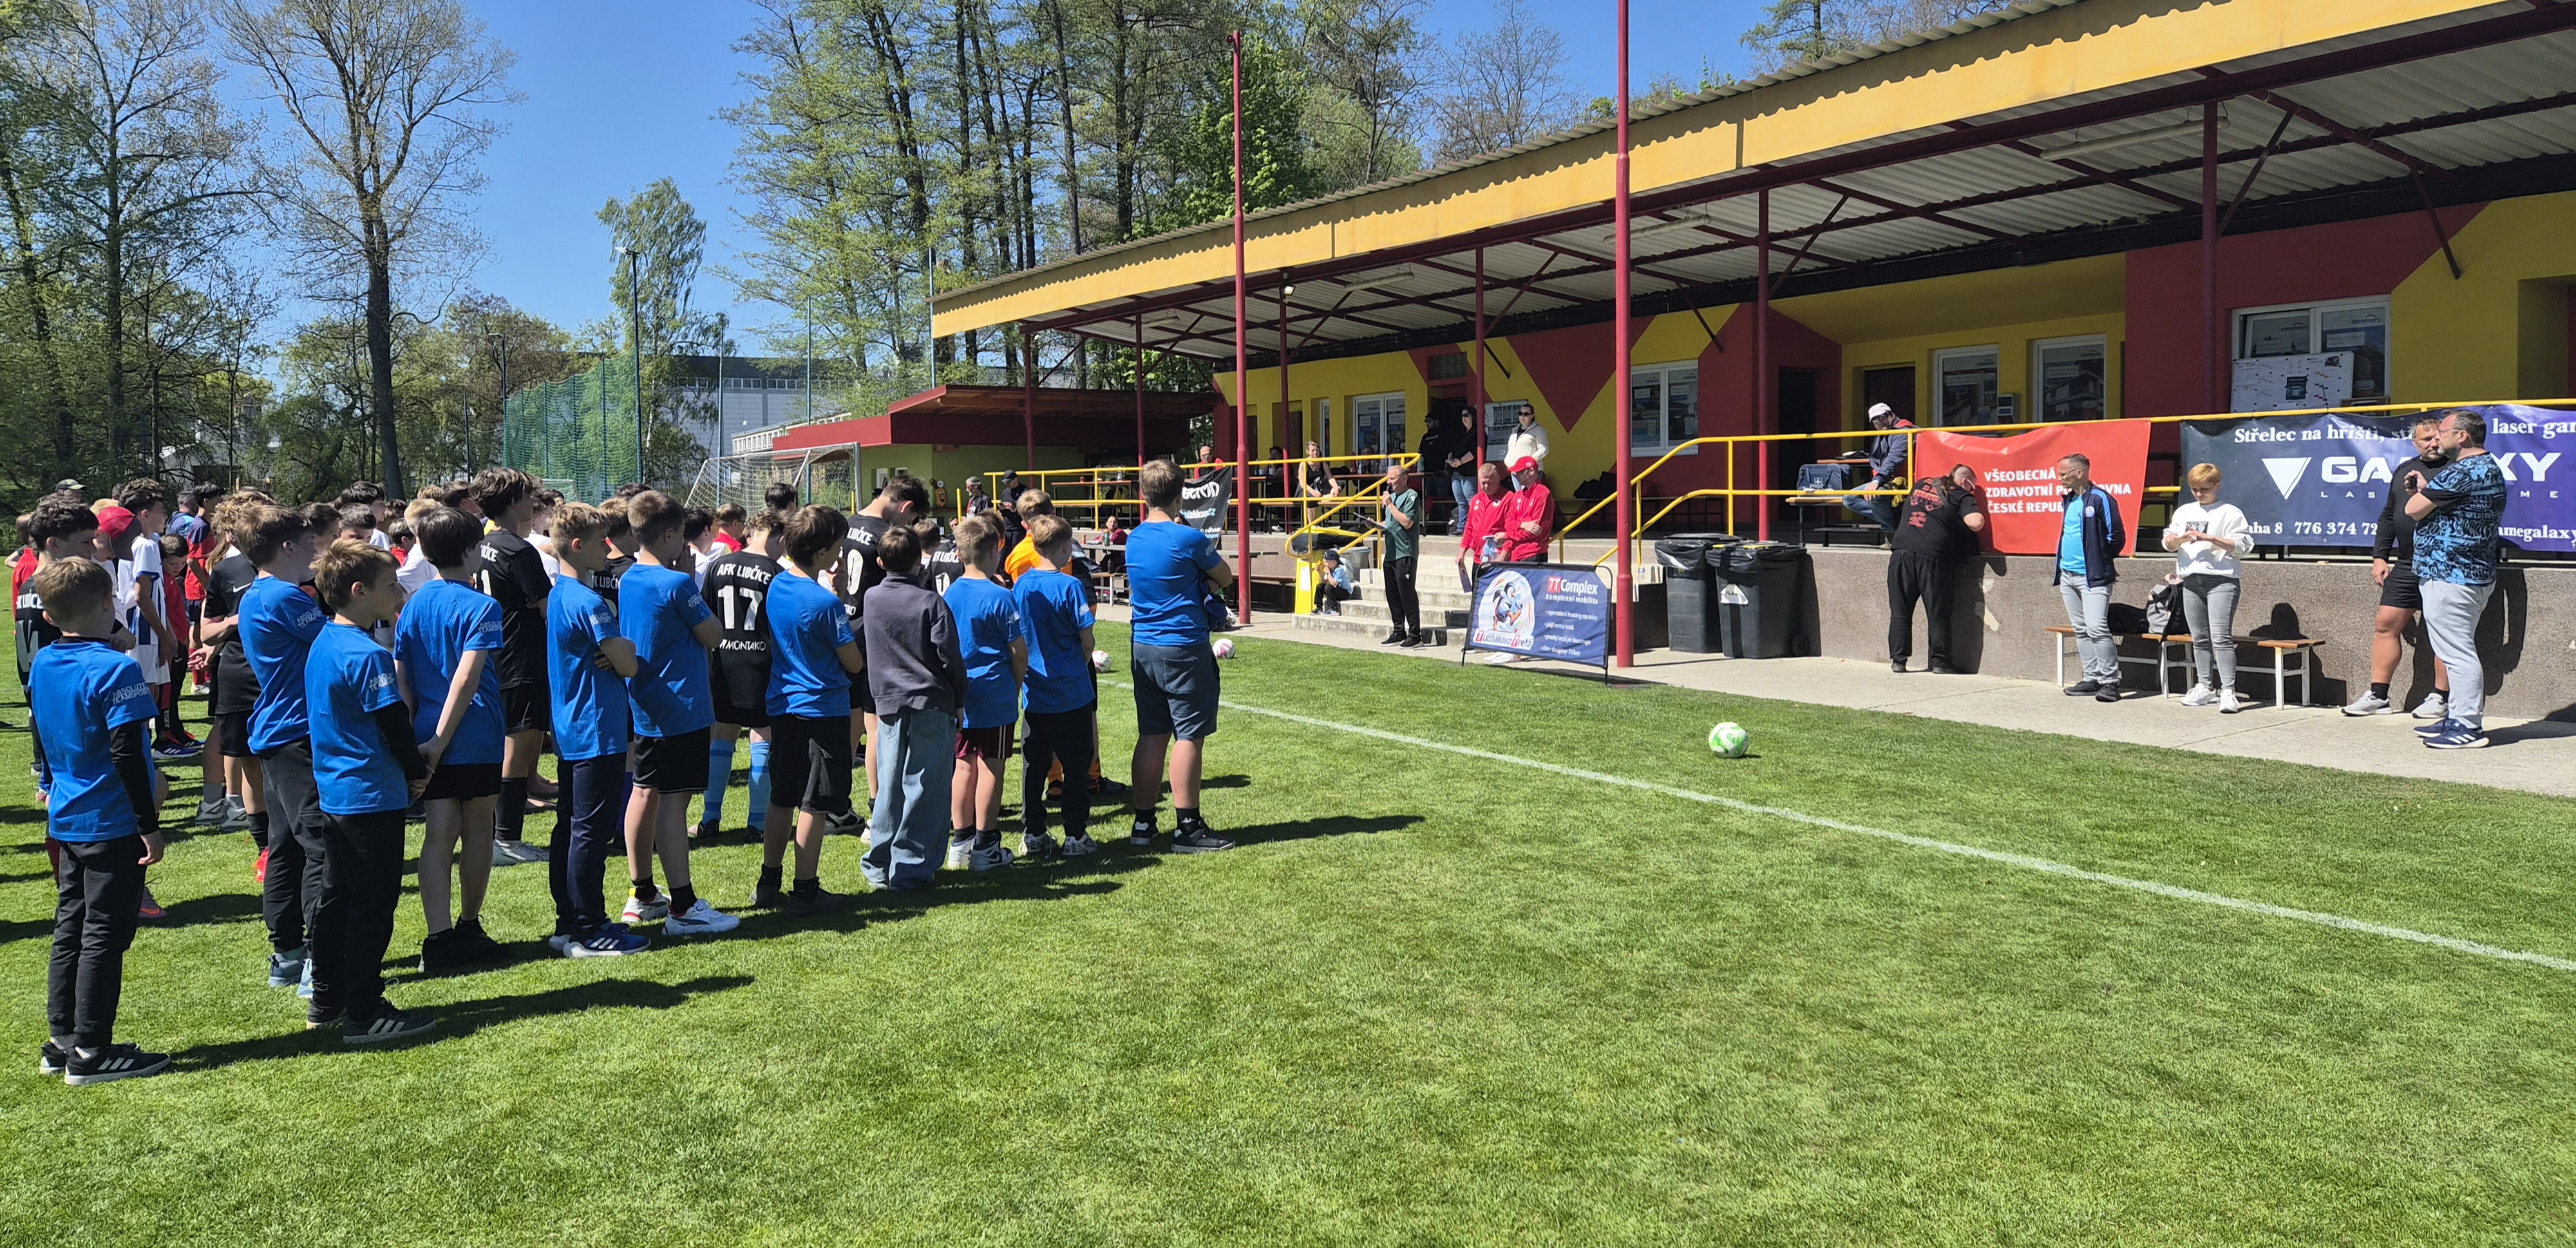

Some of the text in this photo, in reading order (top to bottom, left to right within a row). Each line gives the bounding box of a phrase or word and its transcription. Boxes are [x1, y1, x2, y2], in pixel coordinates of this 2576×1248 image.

[2491, 417, 2538, 435] laser
[2235, 427, 2296, 443] Střelec
[2301, 430, 2322, 440] na
[1984, 467, 2057, 482] VŠEOBECNÁ
[1985, 484, 2053, 498] ZDRAVOTNÍ
[1988, 500, 2064, 513] ČESKÉ REPUB
[2275, 522, 2283, 534] 8
[2295, 521, 2322, 534] 776
[2326, 522, 2357, 534] 374
[2362, 522, 2378, 535] 72
[600, 574, 619, 590] LIBČI
[717, 563, 772, 585] AFK LIBČICE
[1546, 593, 1598, 605] komplexní mobilita
[718, 585, 763, 630] 17
[725, 640, 766, 651] MONTAKO
[111, 686, 150, 704] TEAMSPORT
[113, 683, 146, 699] ABSOLUTE
